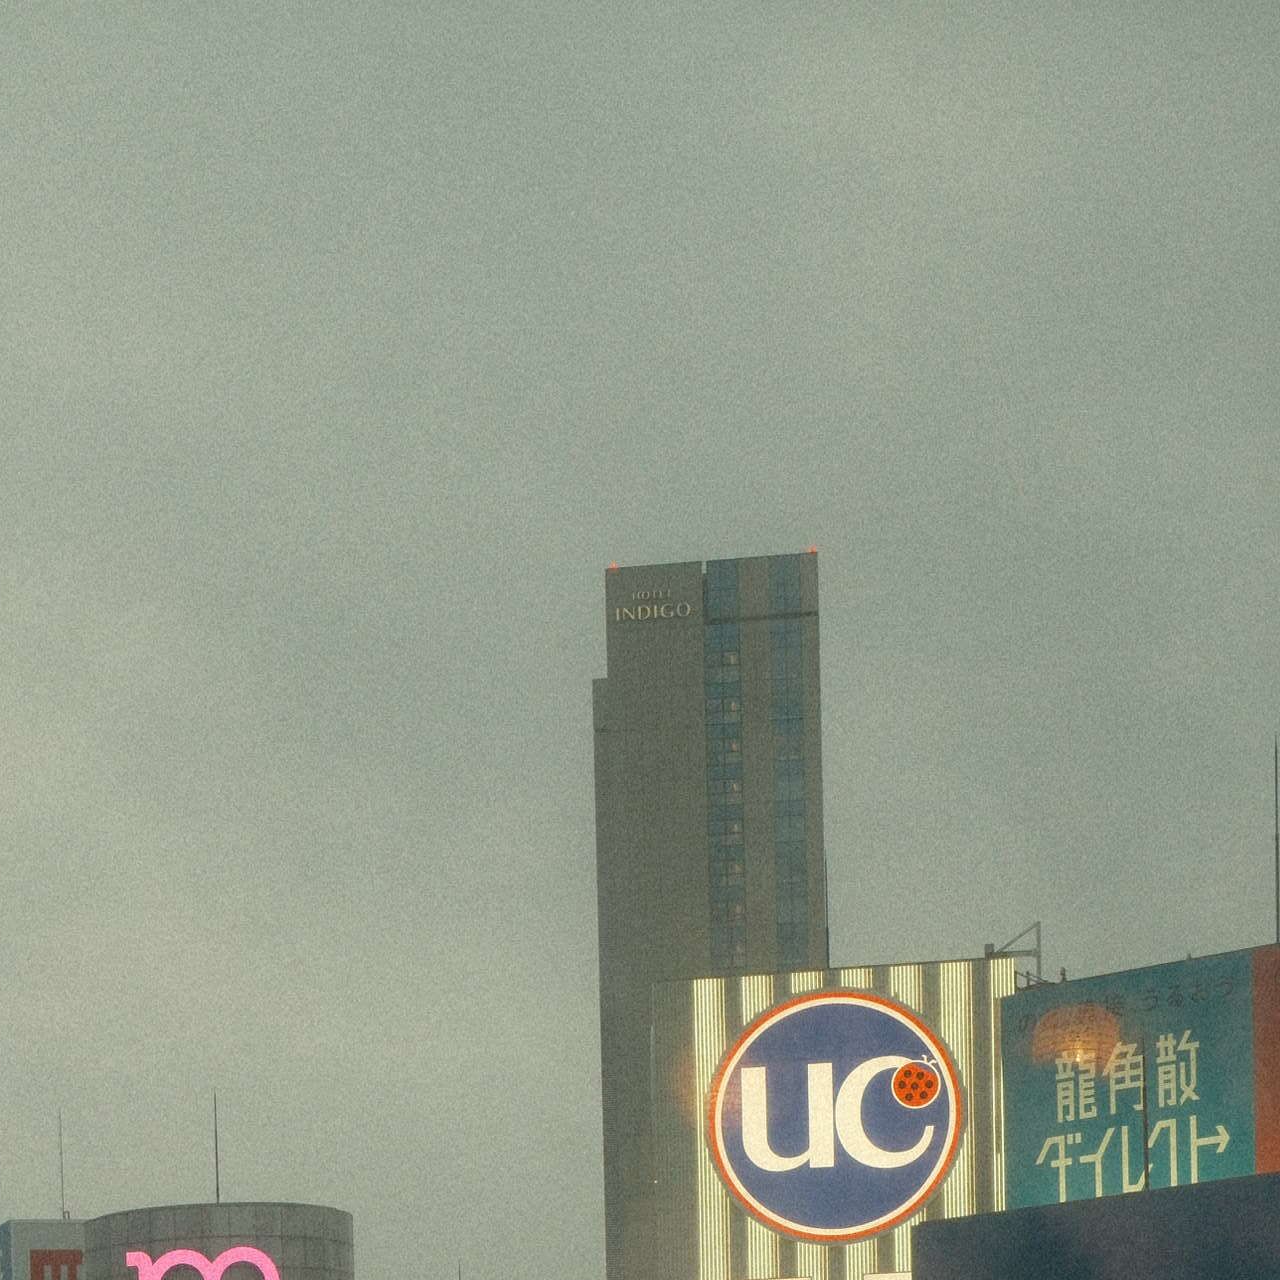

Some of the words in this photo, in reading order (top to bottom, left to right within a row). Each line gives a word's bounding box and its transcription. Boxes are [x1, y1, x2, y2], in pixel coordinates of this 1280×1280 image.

[615, 602, 691, 621] INDIGO
[1055, 1029, 1202, 1124] 龍角散
[1035, 1114, 1231, 1204] ダイレクト
